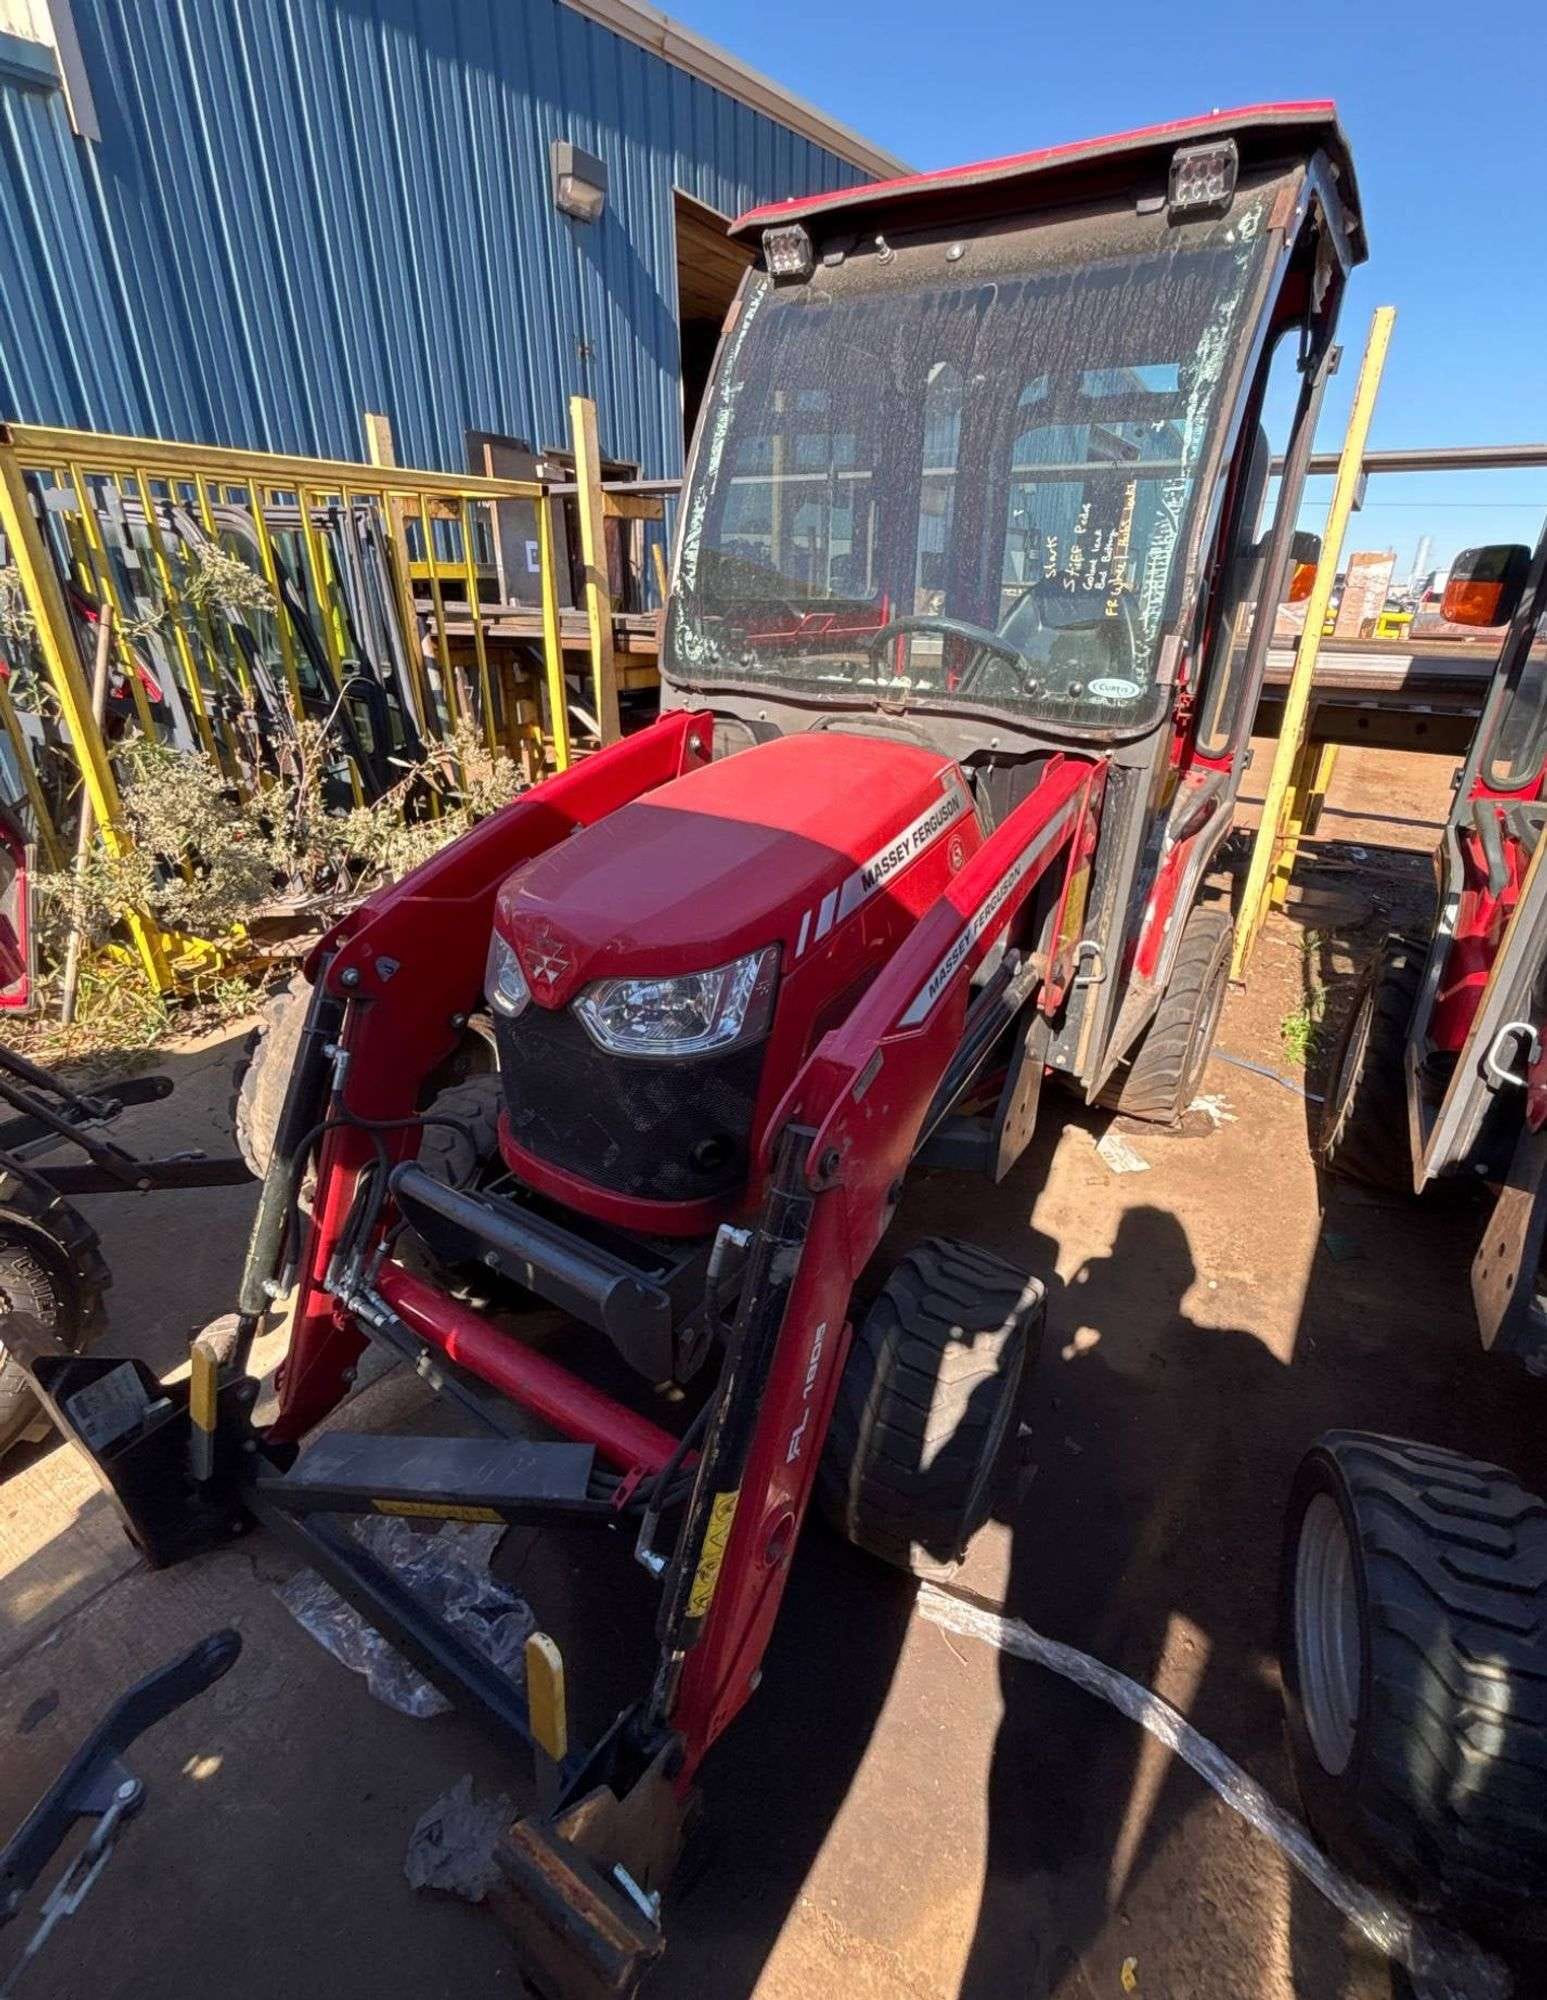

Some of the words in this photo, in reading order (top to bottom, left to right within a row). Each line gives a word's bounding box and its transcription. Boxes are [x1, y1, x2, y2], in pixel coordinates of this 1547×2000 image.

[861, 840, 911, 893] MASSEY
[911, 794, 961, 850] FERGUSON
[928, 926, 973, 998] MASSEY
[972, 863, 1022, 935] FERGUSON
[785, 1407, 810, 1464] FL
